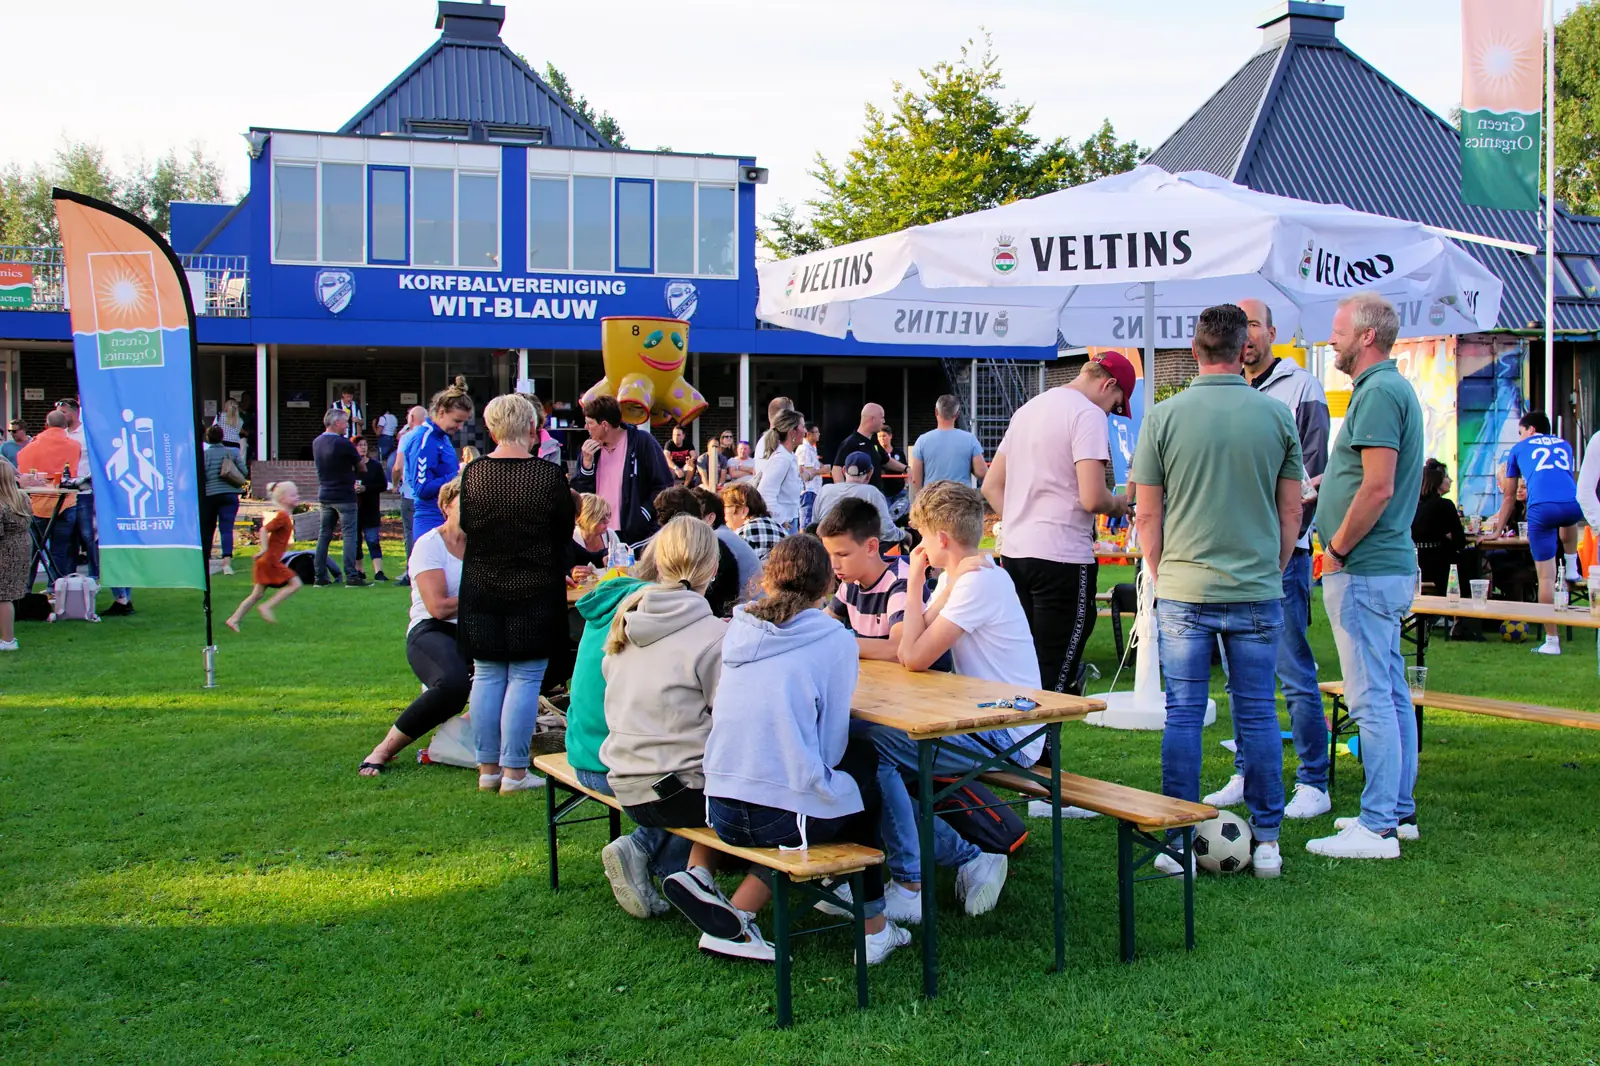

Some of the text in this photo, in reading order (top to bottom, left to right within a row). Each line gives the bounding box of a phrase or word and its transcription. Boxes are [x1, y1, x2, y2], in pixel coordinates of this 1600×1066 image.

[1030, 229, 1193, 272] VELTINS
[799, 251, 874, 294] VELTINS
[399, 275, 627, 297] KORFBALVERENIGING
[430, 296, 599, 320] WIT-BLAUW
[631, 324, 640, 336] 8
[1531, 447, 1570, 472] 23
